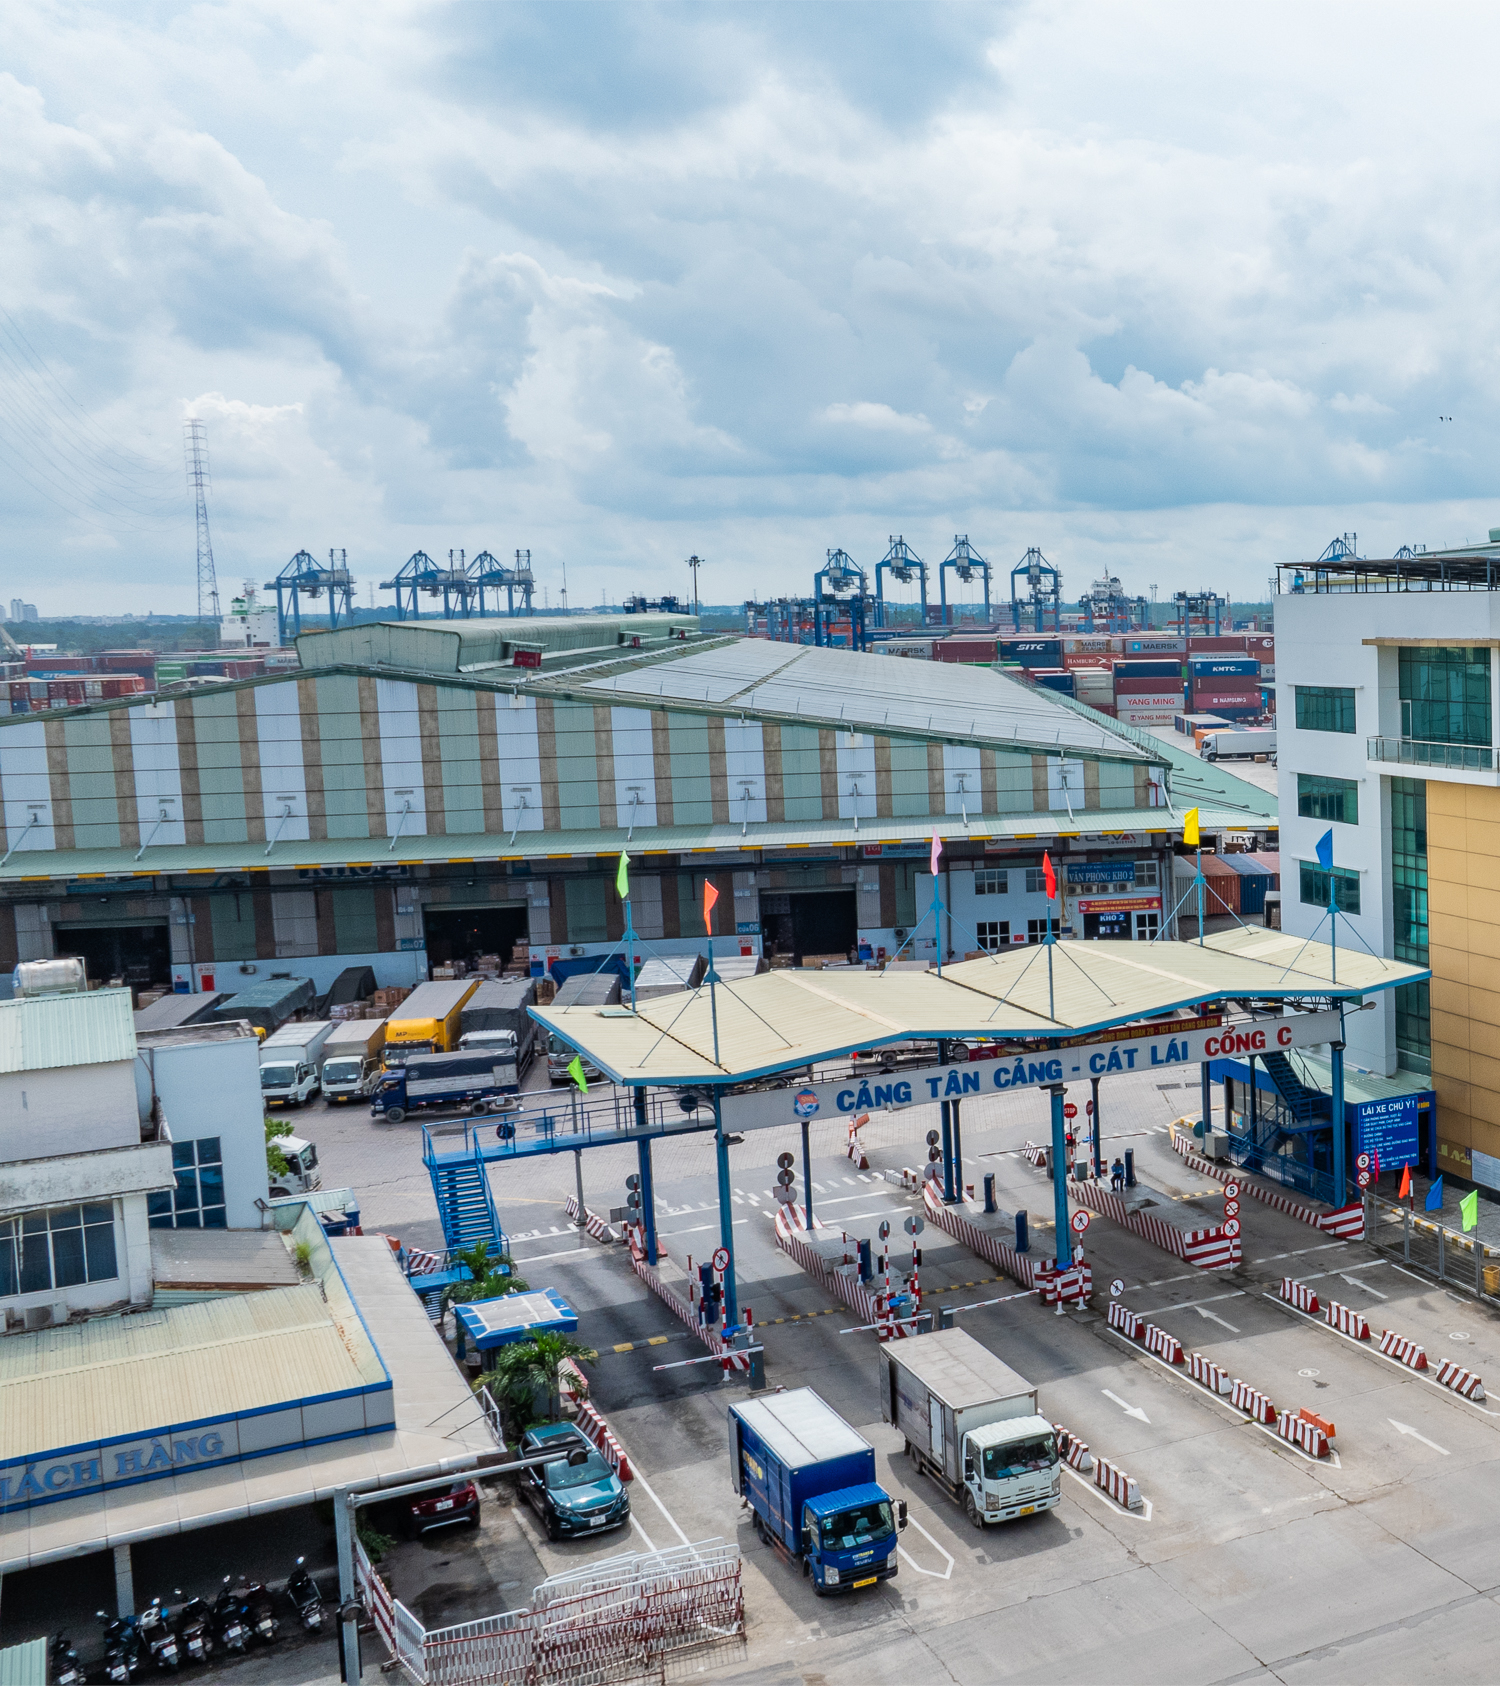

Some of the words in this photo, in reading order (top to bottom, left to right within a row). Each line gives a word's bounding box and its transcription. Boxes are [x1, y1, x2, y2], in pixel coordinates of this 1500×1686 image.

[1016, 643, 1046, 651] SITC
[1143, 642, 1178, 650] MAERSK
[1127, 698, 1150, 706] YANG
[1068, 871, 1084, 882] VĂN
[1085, 869, 1111, 882] PHÒNG
[1112, 871, 1128, 881] KHO
[1128, 871, 1134, 880] 2
[836, 1079, 912, 1112] CẢNG
[926, 1069, 980, 1098] TÂN
[993, 1056, 1063, 1089] CẢNG
[1089, 1045, 1139, 1074] CÁT
[1150, 1037, 1189, 1066] LÁI
[1204, 1025, 1266, 1057] CỔNG
[1276, 1026, 1292, 1046] C
[1362, 1104, 1375, 1116] LÁI
[1376, 1104, 1387, 1114] XE
[1388, 1100, 1404, 1112] CHÚ
[1361, 1156, 1367, 1166] 5
[1229, 1186, 1235, 1196] 5
[114, 1431, 224, 1476] HÀNG
